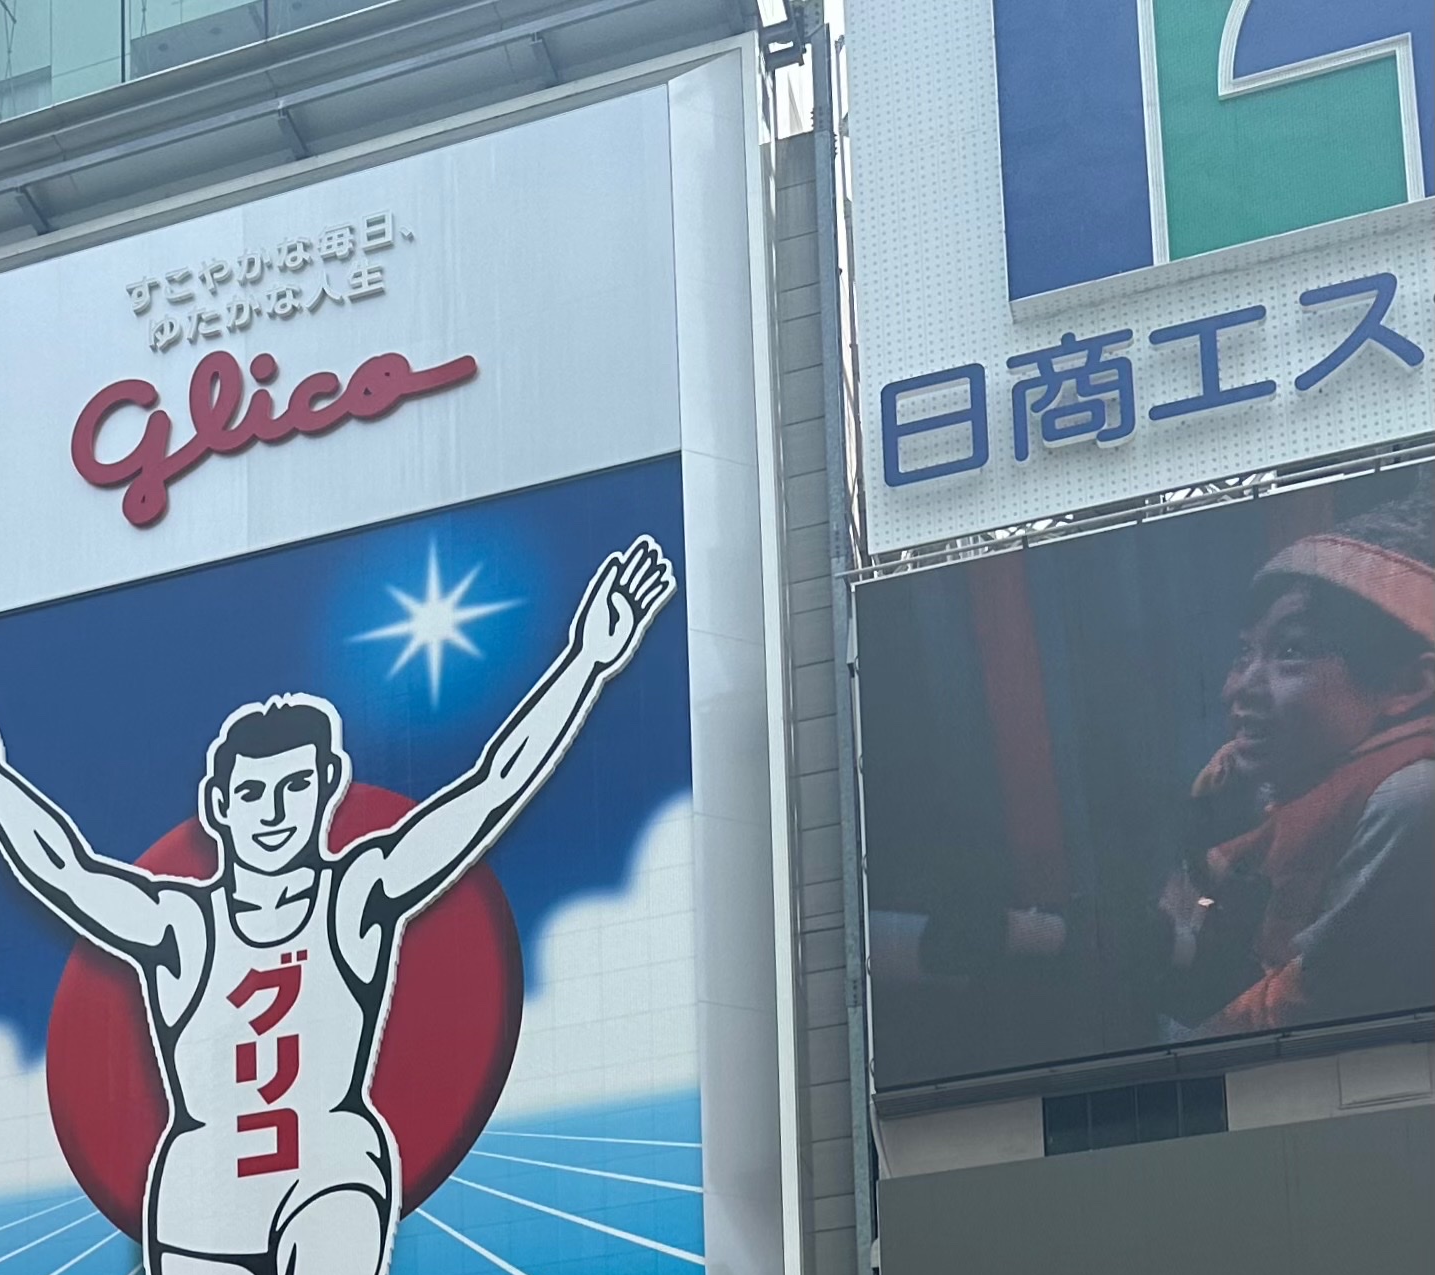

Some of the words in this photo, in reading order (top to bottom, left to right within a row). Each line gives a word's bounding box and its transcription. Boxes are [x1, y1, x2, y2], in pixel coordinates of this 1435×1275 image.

[126, 209, 415, 317] すこやかな毎日、
[147, 258, 386, 352] ゆたかな人生
[880, 271, 1425, 488] 日商エス
[225, 949, 309, 1178] グリコ
